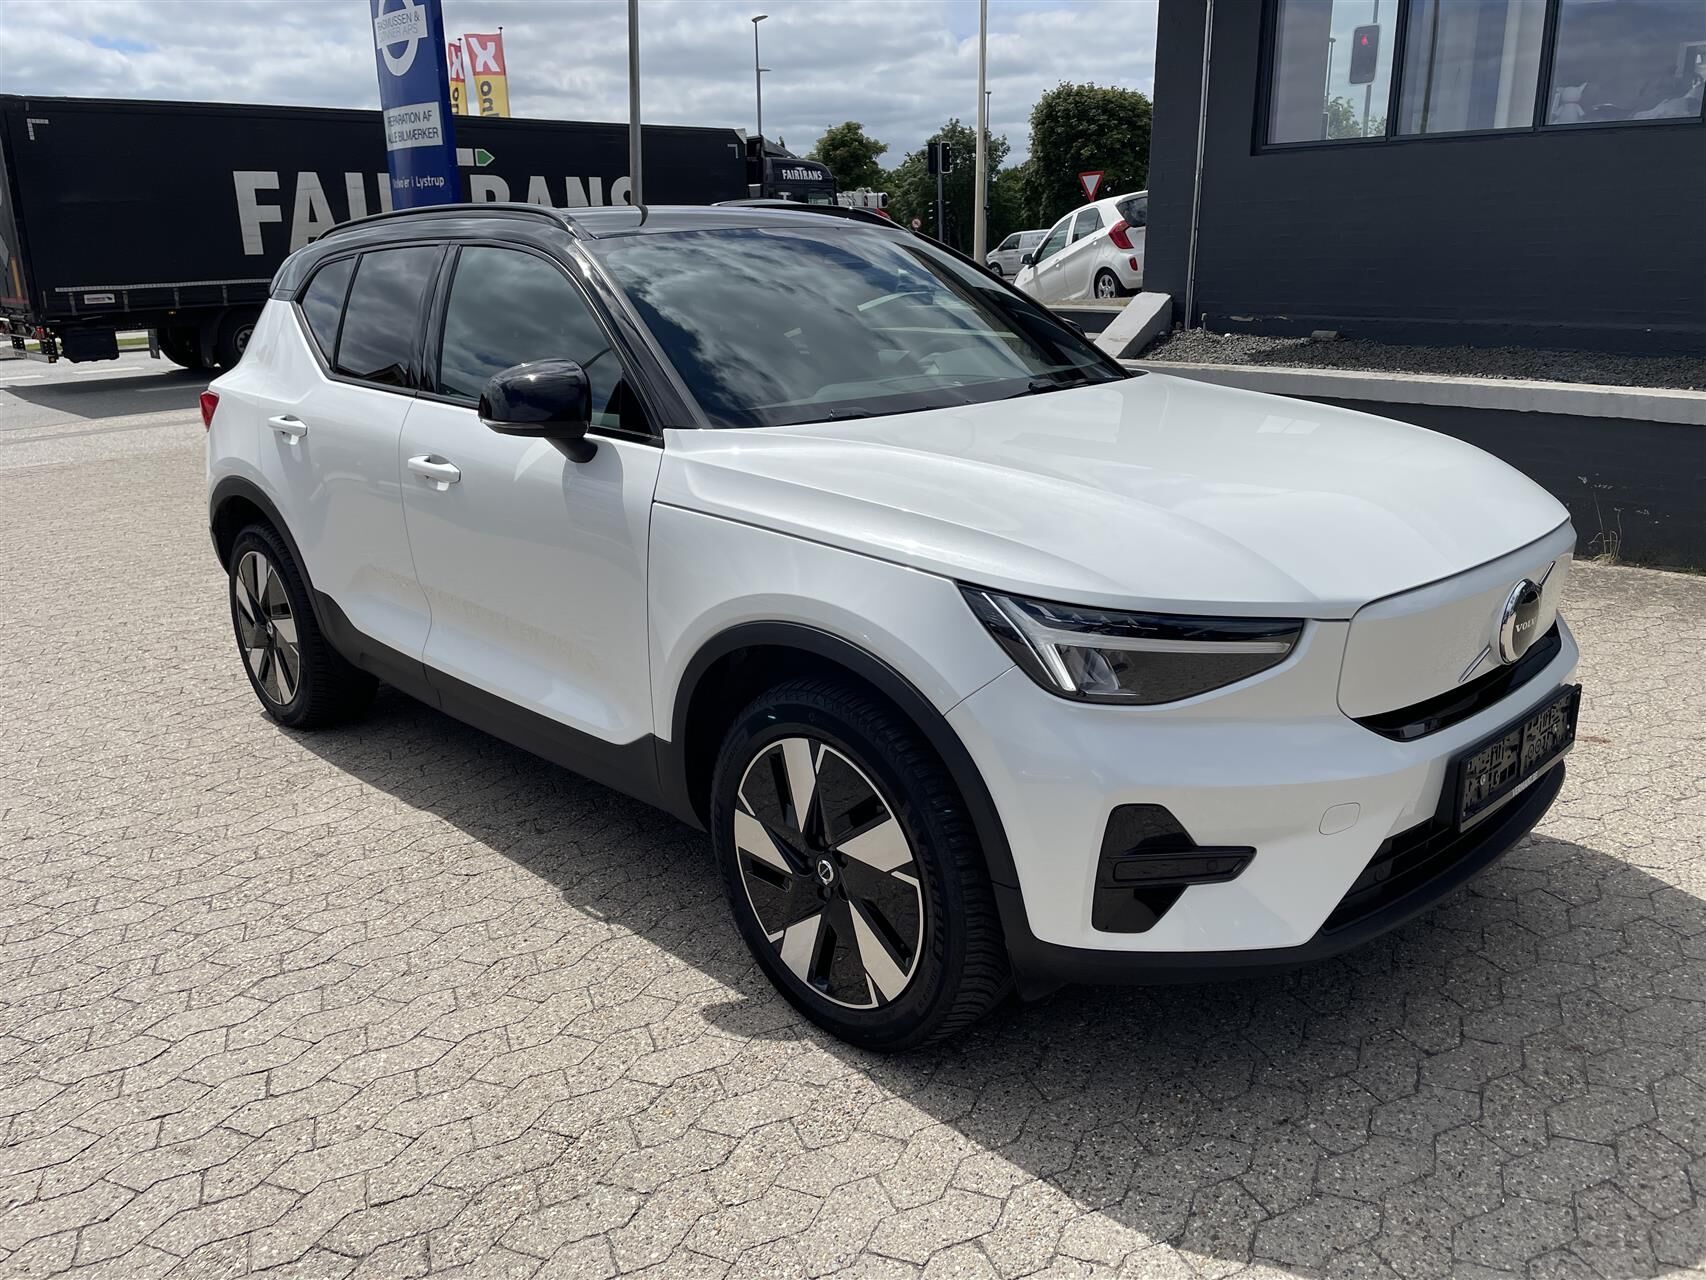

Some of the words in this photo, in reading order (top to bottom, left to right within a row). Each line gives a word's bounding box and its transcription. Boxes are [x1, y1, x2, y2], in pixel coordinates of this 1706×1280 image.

[422, 110, 433, 122] AF
[781, 166, 823, 181] FAIRTRANS
[415, 175, 445, 190] Lystrup
